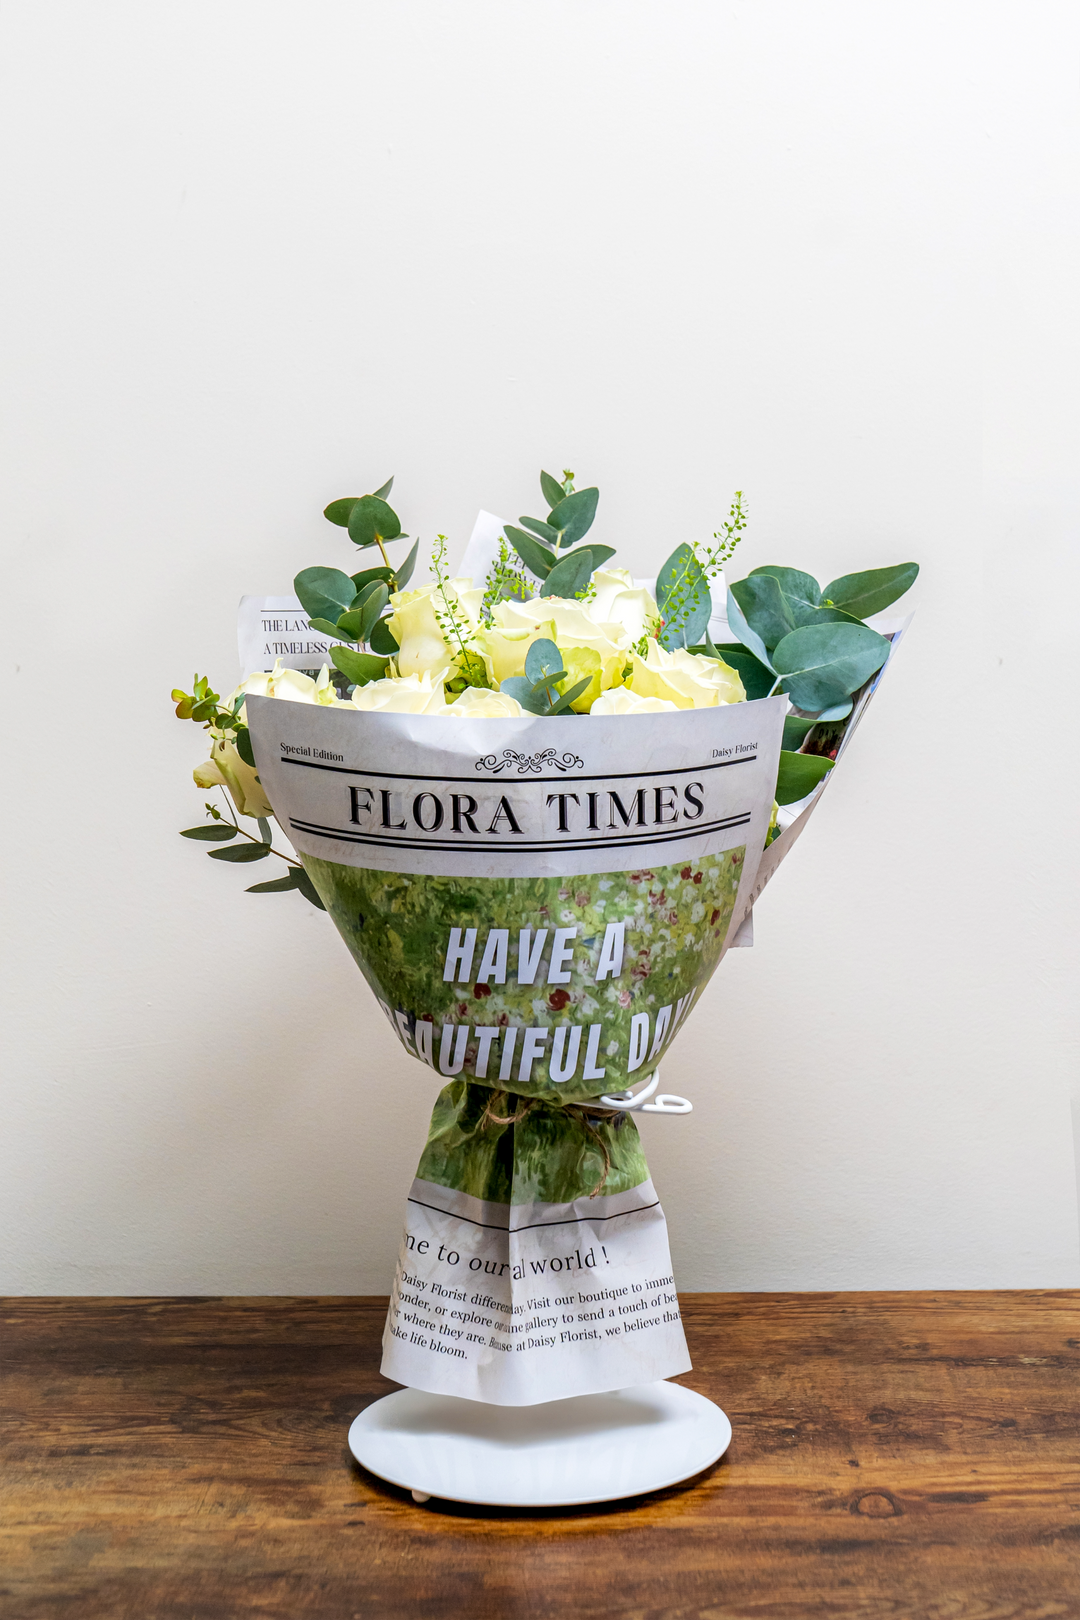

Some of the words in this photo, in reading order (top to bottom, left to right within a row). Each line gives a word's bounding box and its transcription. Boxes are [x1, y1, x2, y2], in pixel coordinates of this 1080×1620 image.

[261, 619, 283, 632] THE
[263, 643, 271, 654] A
[272, 641, 328, 655] TIMELESS
[280, 742, 311, 756] Special
[313, 748, 344, 762] Edition
[712, 747, 733, 758] Daisy
[735, 742, 758, 754] Florist
[347, 785, 525, 835] FLORA
[546, 781, 705, 833] TIMES
[443, 926, 578, 985] HAVE
[595, 921, 625, 981] A
[378, 997, 606, 1083] BEAUTIFUL
[437, 1244, 460, 1265] to
[469, 1257, 510, 1277] our
[530, 1247, 597, 1275] world
[430, 1283, 467, 1301] Florist
[527, 1297, 551, 1310] Visit
[554, 1295, 575, 1306] our
[578, 1286, 628, 1303] boutique
[631, 1283, 643, 1293] to
[434, 1307, 448, 1317] or
[450, 1310, 492, 1327] explore
[525, 1316, 558, 1333] gallery
[562, 1314, 574, 1324] to
[577, 1308, 605, 1322] send
[608, 1309, 615, 1317] a
[618, 1299, 648, 1315] touch
[650, 1294, 662, 1308] of
[403, 1311, 436, 1331] where
[439, 1324, 464, 1340] they
[466, 1332, 487, 1346] are.
[516, 1340, 526, 1351] at
[527, 1335, 556, 1349] Daisy
[560, 1329, 602, 1343] Florist,
[605, 1326, 621, 1336] we
[624, 1316, 661, 1333] believe
[410, 1331, 427, 1347] life
[429, 1339, 468, 1359] bloom.
